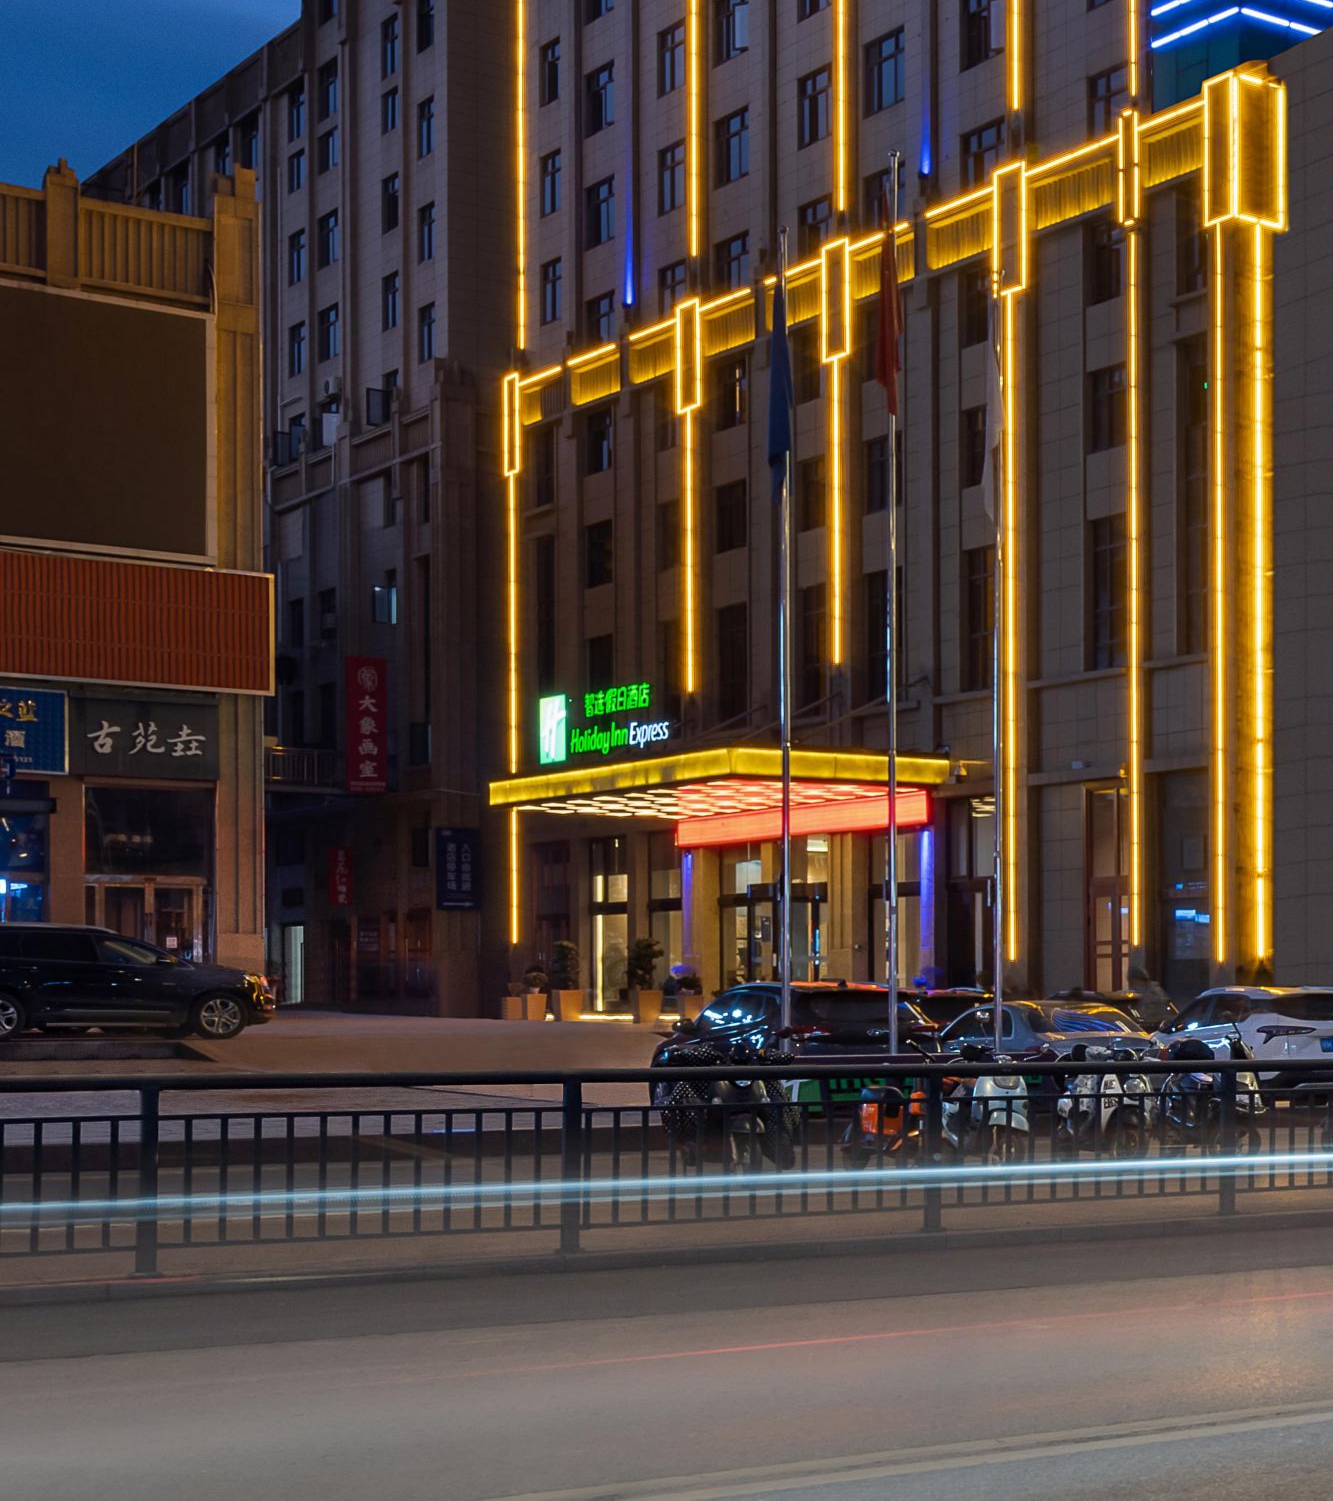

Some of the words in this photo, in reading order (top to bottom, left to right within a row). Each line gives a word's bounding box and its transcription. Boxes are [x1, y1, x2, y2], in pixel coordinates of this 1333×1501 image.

[584, 682, 651, 718] 智选假日酒店
[358, 694, 379, 778] 大象画室
[570, 725, 610, 755] Holiday
[611, 721, 628, 747] Inn
[629, 721, 670, 748] Express
